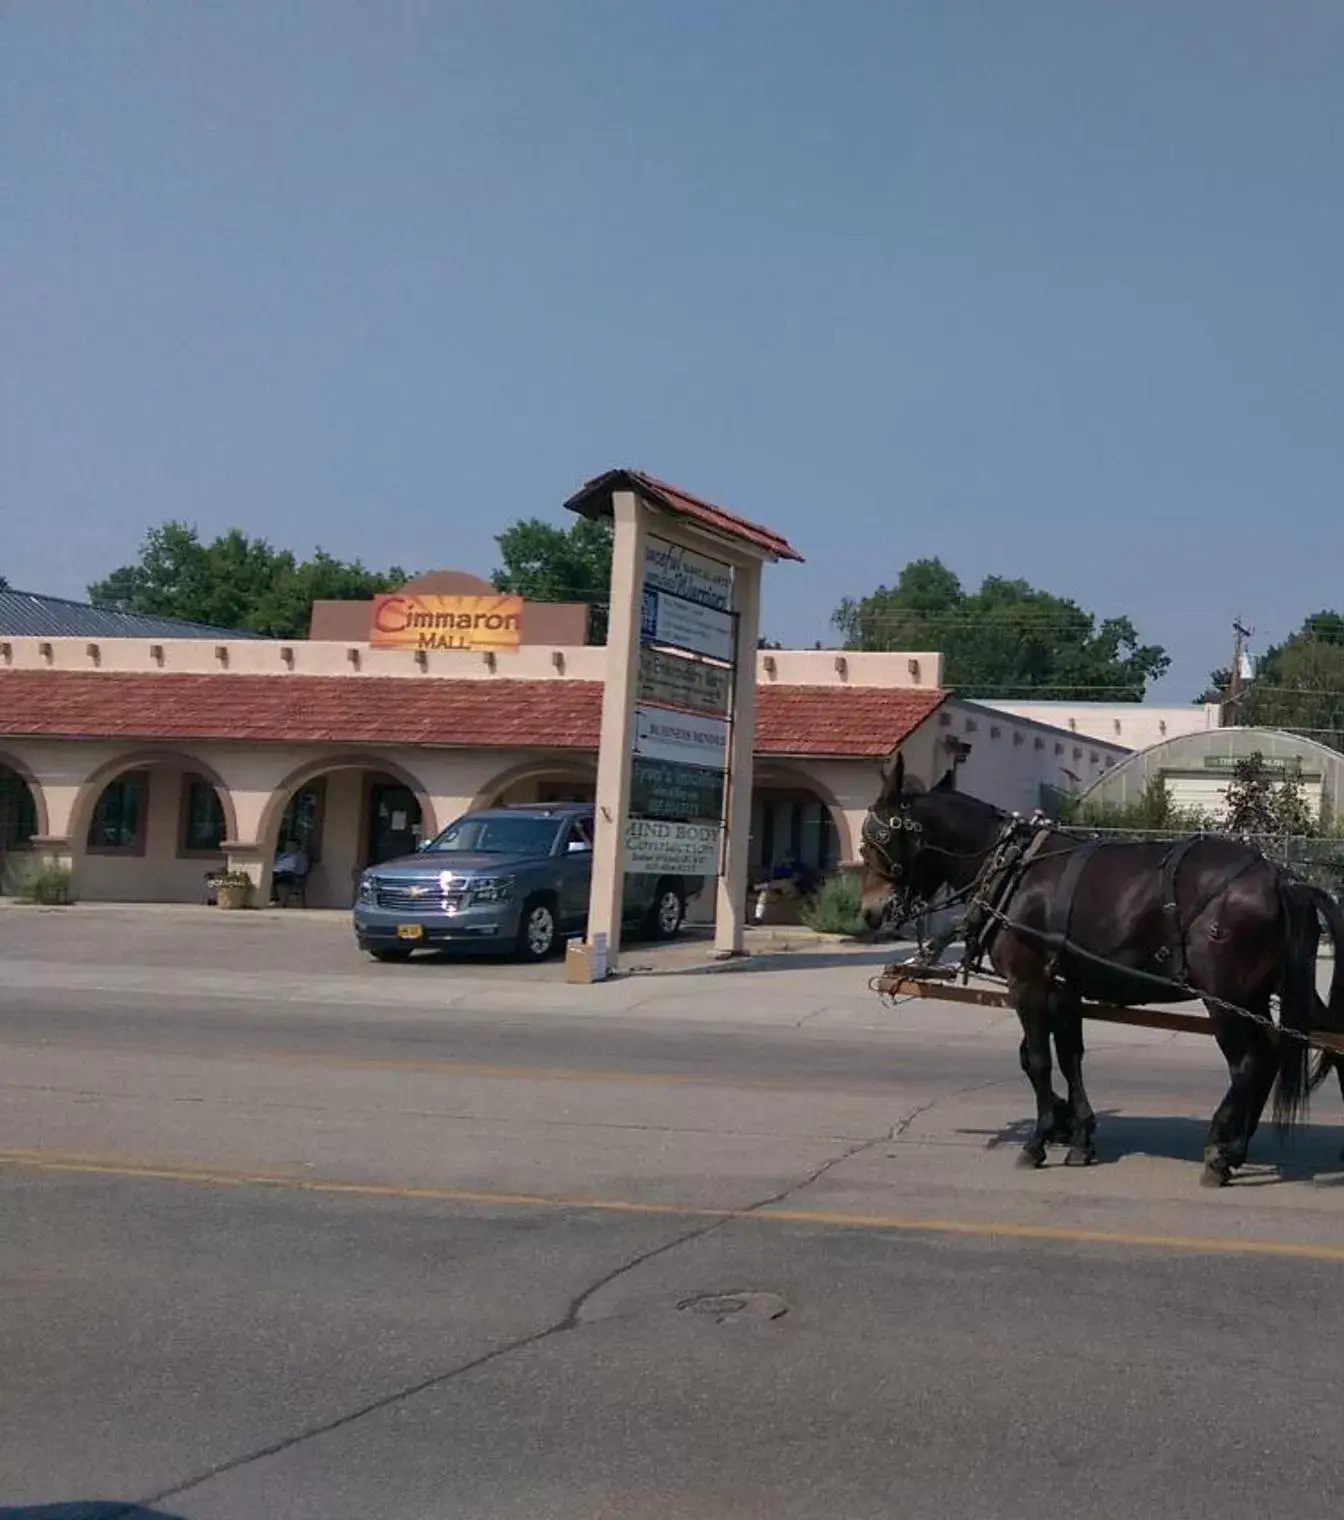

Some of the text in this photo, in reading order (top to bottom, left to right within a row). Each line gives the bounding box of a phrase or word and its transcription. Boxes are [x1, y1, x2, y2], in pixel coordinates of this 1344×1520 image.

[375, 597, 520, 633] Cimmaron
[418, 632, 471, 651] MALL
[676, 826, 720, 842] BODY
